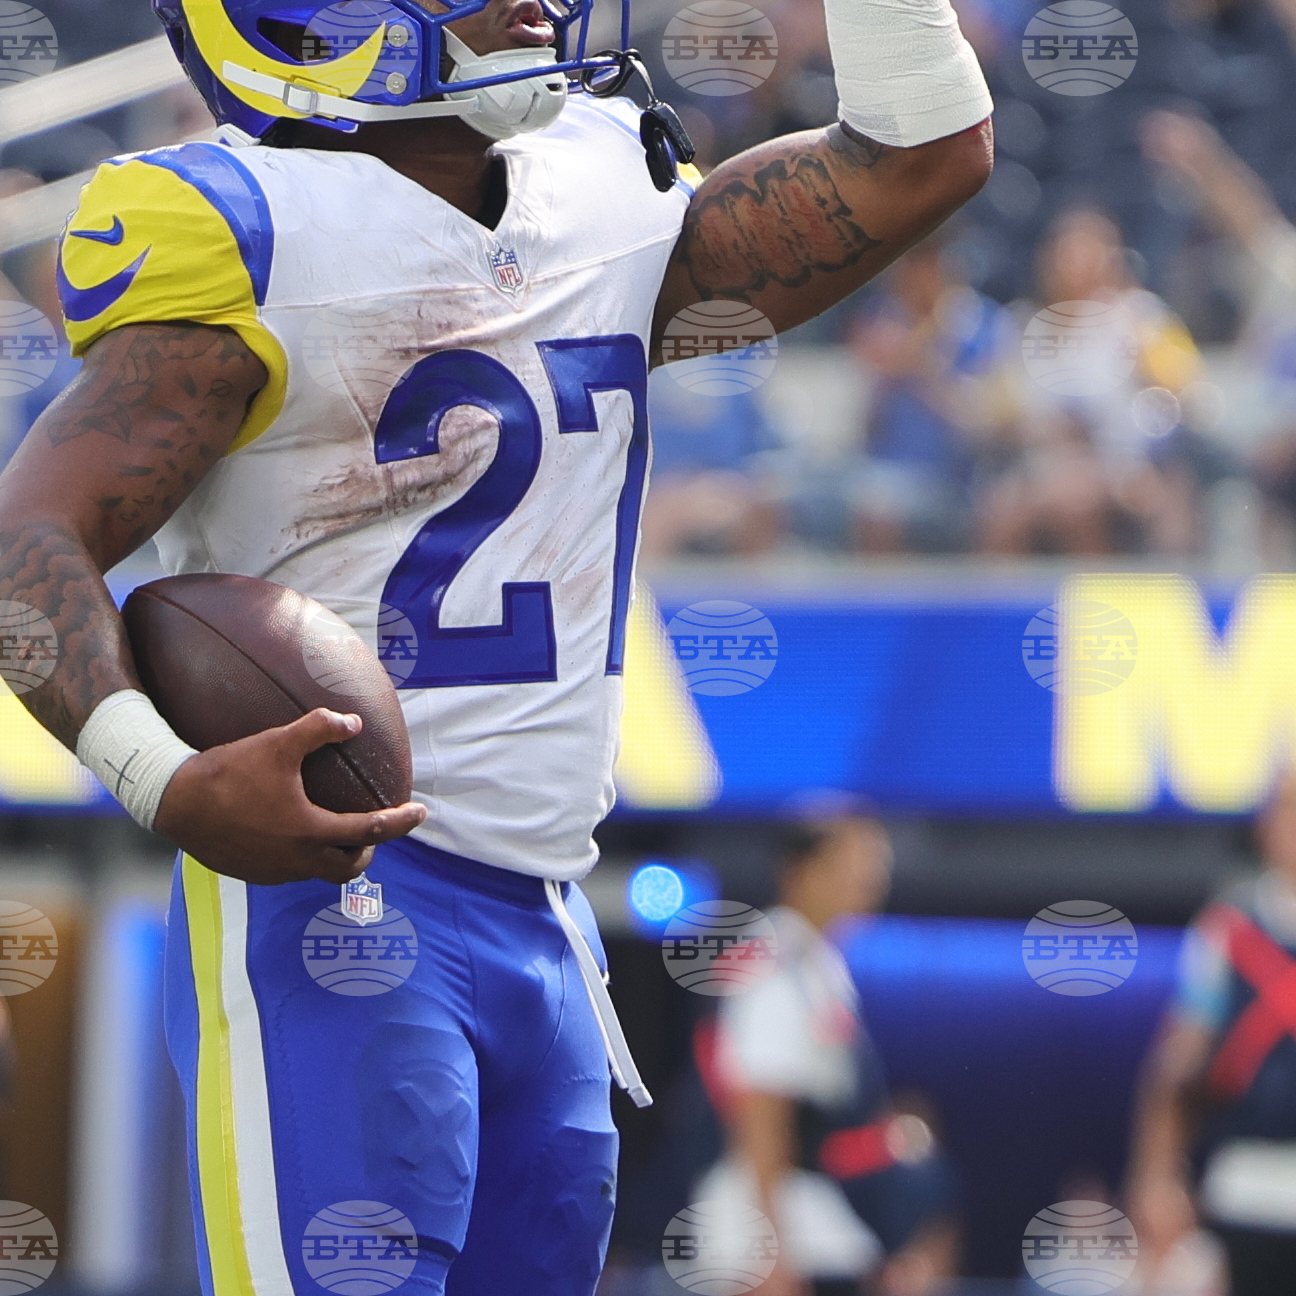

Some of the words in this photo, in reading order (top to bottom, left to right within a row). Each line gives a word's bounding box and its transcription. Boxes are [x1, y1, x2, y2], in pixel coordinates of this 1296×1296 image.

[496, 266, 522, 286] NFL
[374, 333, 650, 690] 27
[348, 895, 377, 917] NFL
